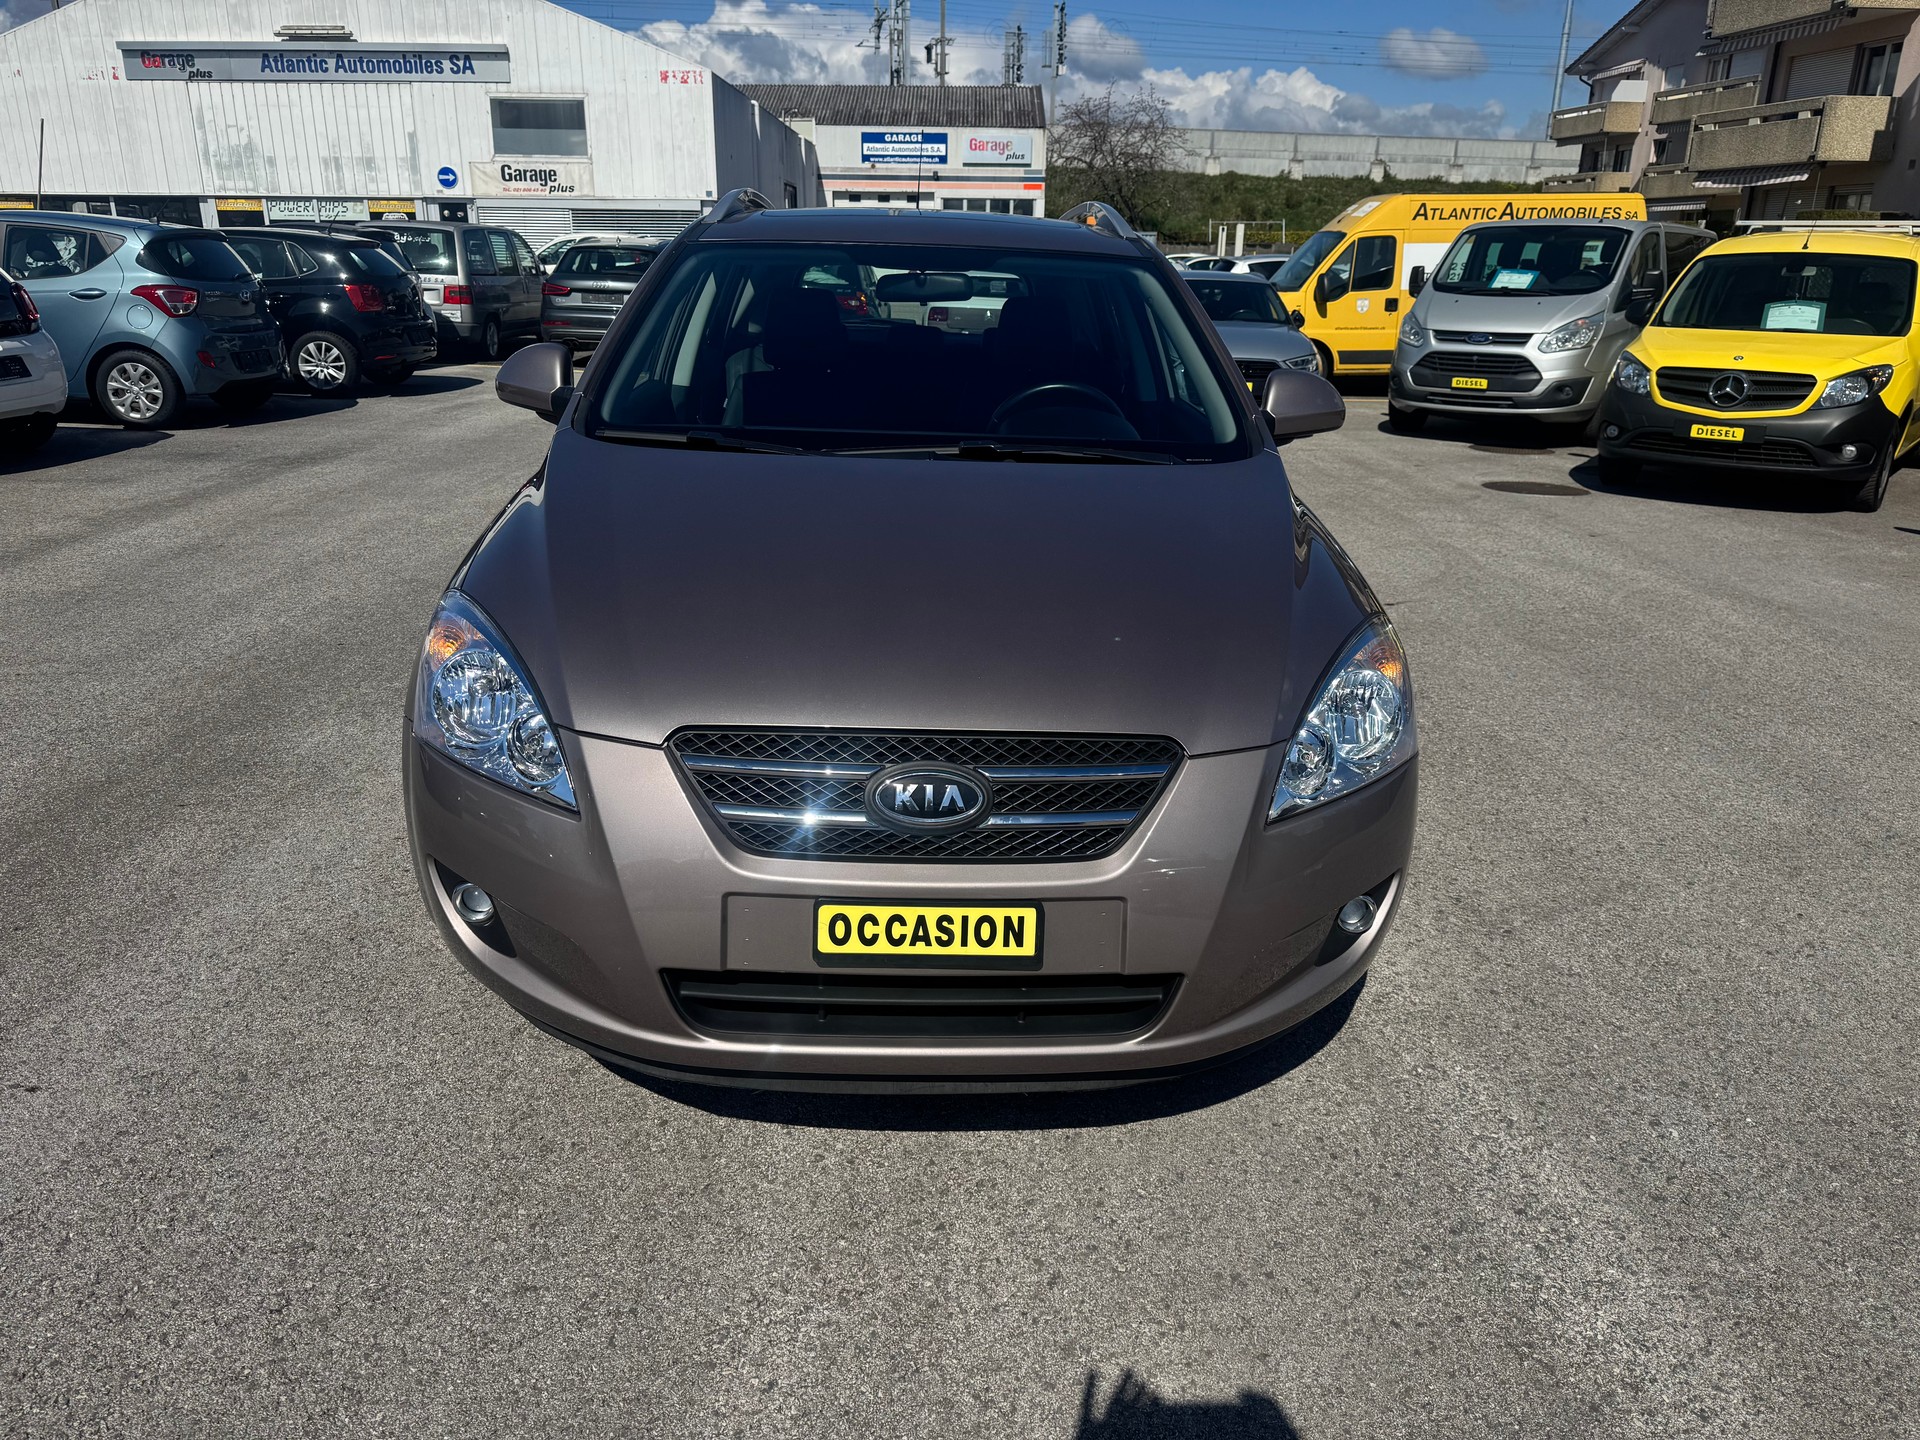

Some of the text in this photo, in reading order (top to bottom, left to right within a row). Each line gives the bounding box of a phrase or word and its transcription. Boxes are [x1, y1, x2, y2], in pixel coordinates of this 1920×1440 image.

[140, 51, 195, 73] Garage
[260, 53, 475, 75] Atlantic Automobiles SA
[188, 68, 213, 82] plus
[884, 134, 922, 142] GARAGE
[969, 137, 1014, 155] Garage
[866, 145, 890, 153] Atlantic
[891, 145, 929, 153] Automobies
[1005, 152, 1025, 161] plus
[500, 164, 557, 187] Garage
[549, 183, 575, 194] plus
[1412, 202, 1498, 221] ATLANTIC
[1624, 211, 1639, 220] SA
[1455, 379, 1484, 387] DIESEL
[1697, 427, 1737, 439] DIESEL
[893, 783, 966, 812] KIA
[828, 912, 1025, 949] OCCASION
